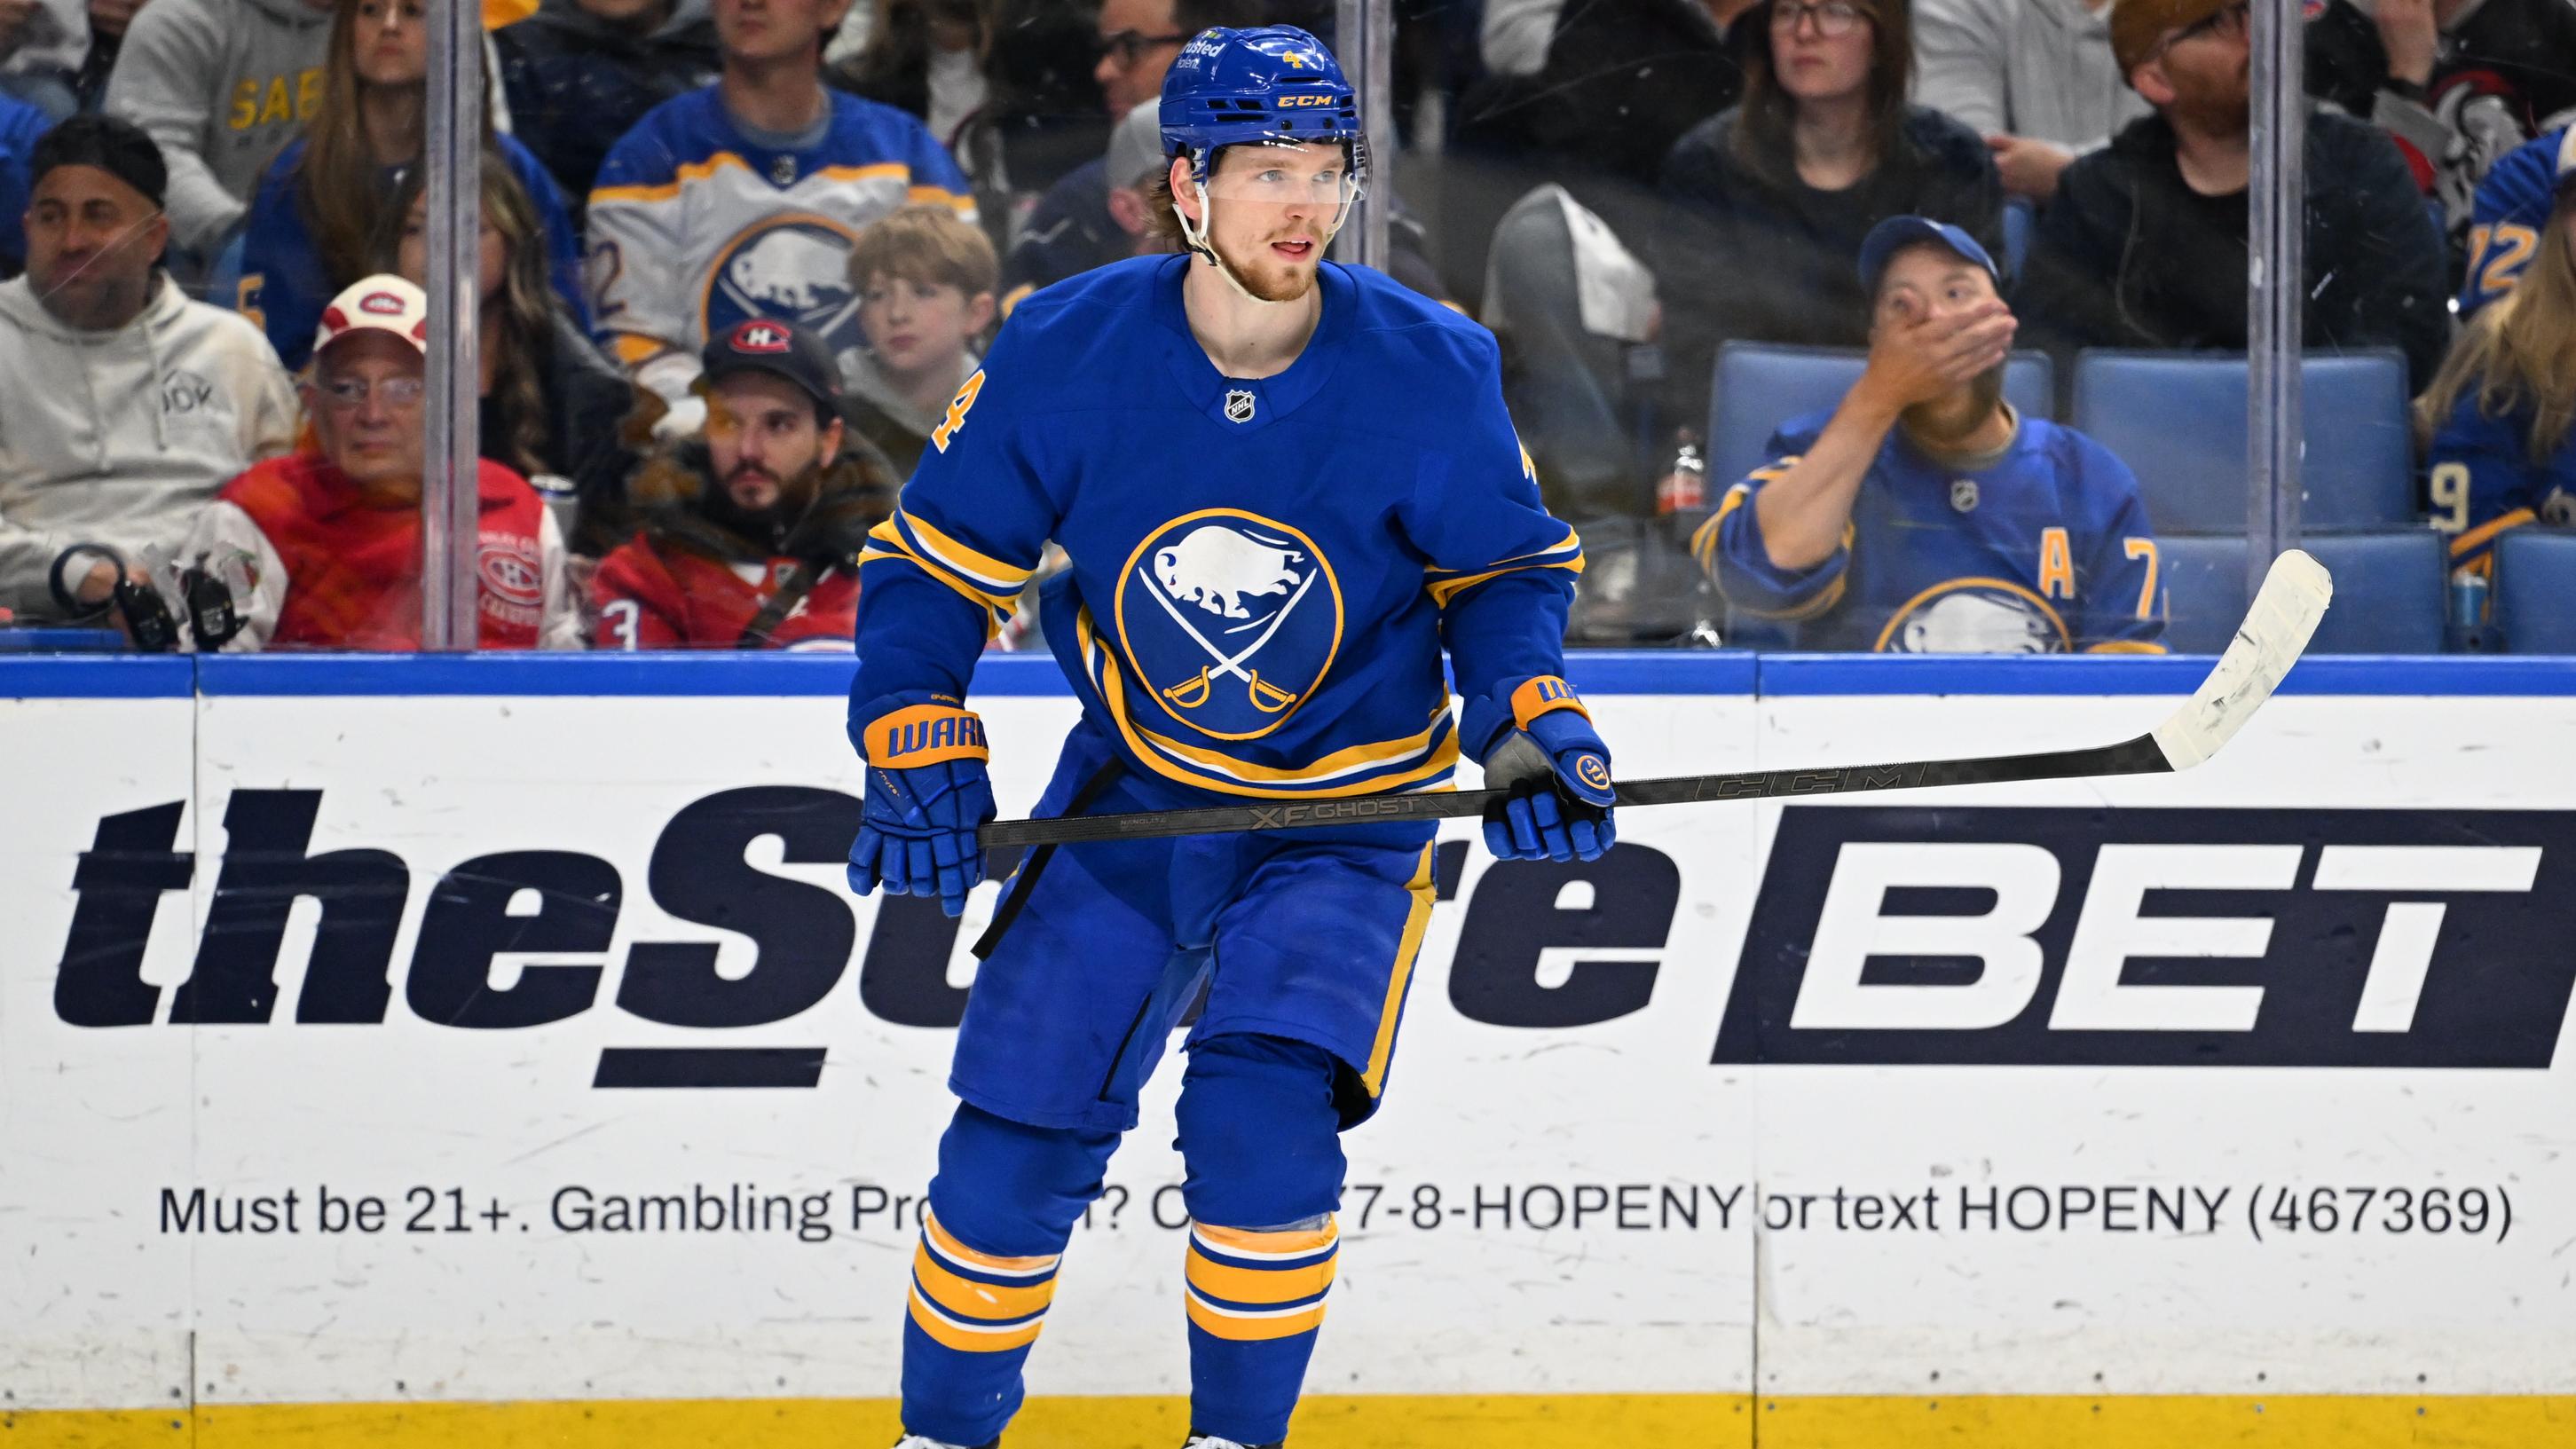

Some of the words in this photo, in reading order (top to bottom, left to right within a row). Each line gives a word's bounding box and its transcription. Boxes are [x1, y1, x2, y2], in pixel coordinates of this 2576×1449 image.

[1278, 95, 1333, 107] CCM
[931, 368, 986, 455] 4
[2429, 461, 2470, 534] 9
[2038, 526, 2076, 600] A
[2122, 536, 2170, 622] 7
[1315, 798, 1421, 819] GHOST
[53, 784, 1681, 1028] theSe
[1789, 842, 2543, 1033] BET
[160, 1187, 299, 1233] Must
[318, 1184, 386, 1233] be
[404, 1185, 530, 1233] 21+.
[550, 1184, 832, 1243] Gambling
[1333, 1184, 1744, 1231] 7-8-HOPENY
[1764, 1193, 1816, 1231] or
[1833, 1187, 1939, 1231] text
[1958, 1185, 2230, 1231] HOPENY
[2248, 1185, 2513, 1242] (467369)
